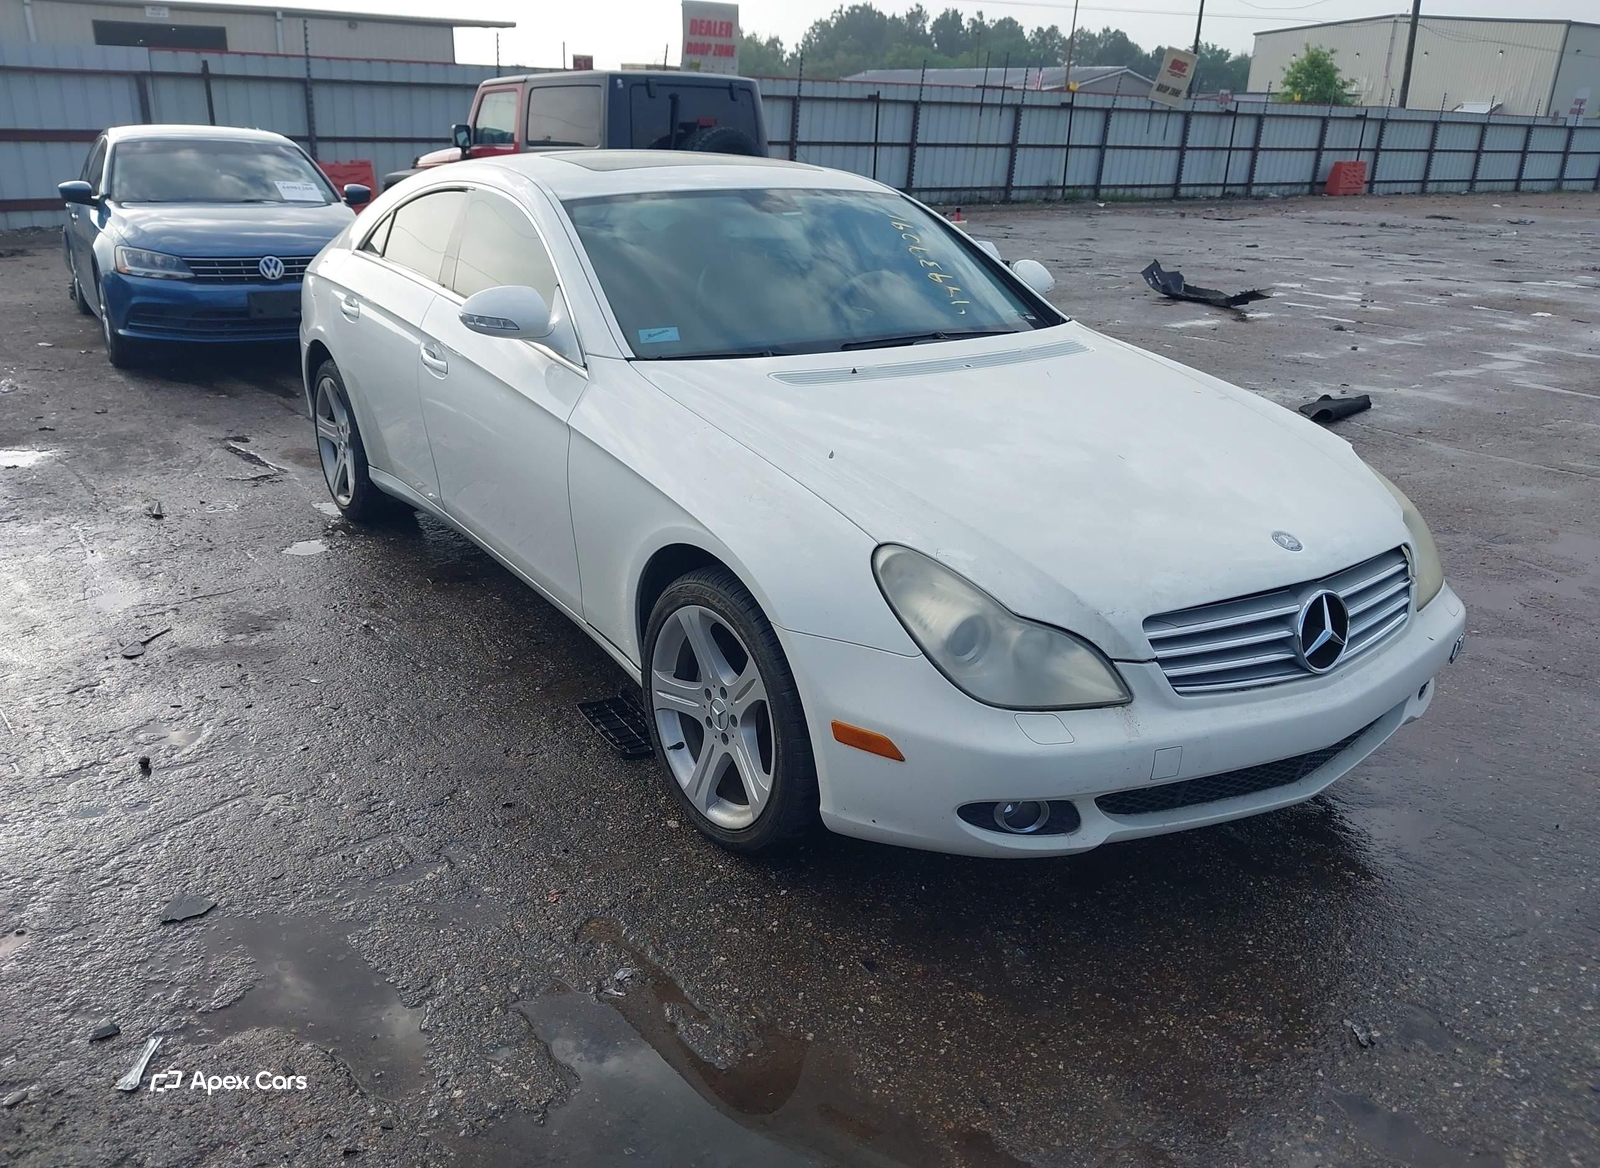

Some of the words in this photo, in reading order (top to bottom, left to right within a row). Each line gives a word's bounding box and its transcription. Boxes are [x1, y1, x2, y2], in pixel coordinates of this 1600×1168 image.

[690, 19, 733, 38] DEALER
[686, 42, 712, 55] DROP
[713, 44, 735, 57] ZONE
